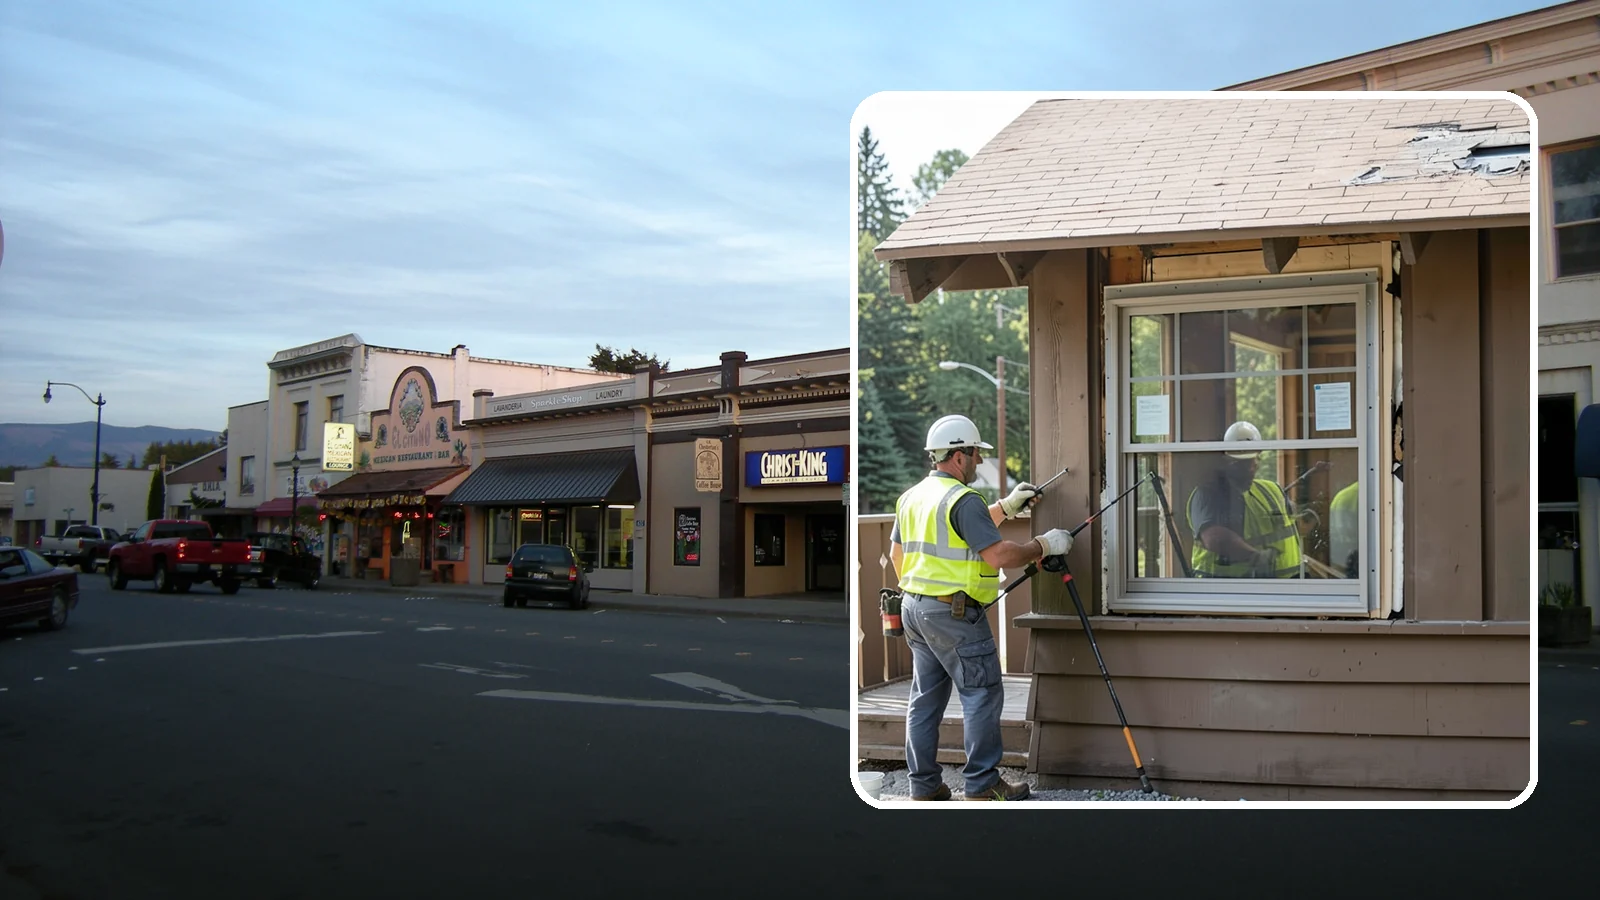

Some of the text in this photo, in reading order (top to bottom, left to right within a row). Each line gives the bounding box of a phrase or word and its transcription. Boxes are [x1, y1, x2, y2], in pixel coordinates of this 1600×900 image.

[531, 394, 583, 409] Sparkle Shop
[595, 389, 623, 400] LAUNDRY
[493, 403, 523, 413] LAVANDERIA
[373, 455, 396, 464] MEXICAN
[397, 451, 433, 462] RESTAURANT
[437, 450, 450, 459] BAR
[760, 449, 827, 478] CHRIST KING
